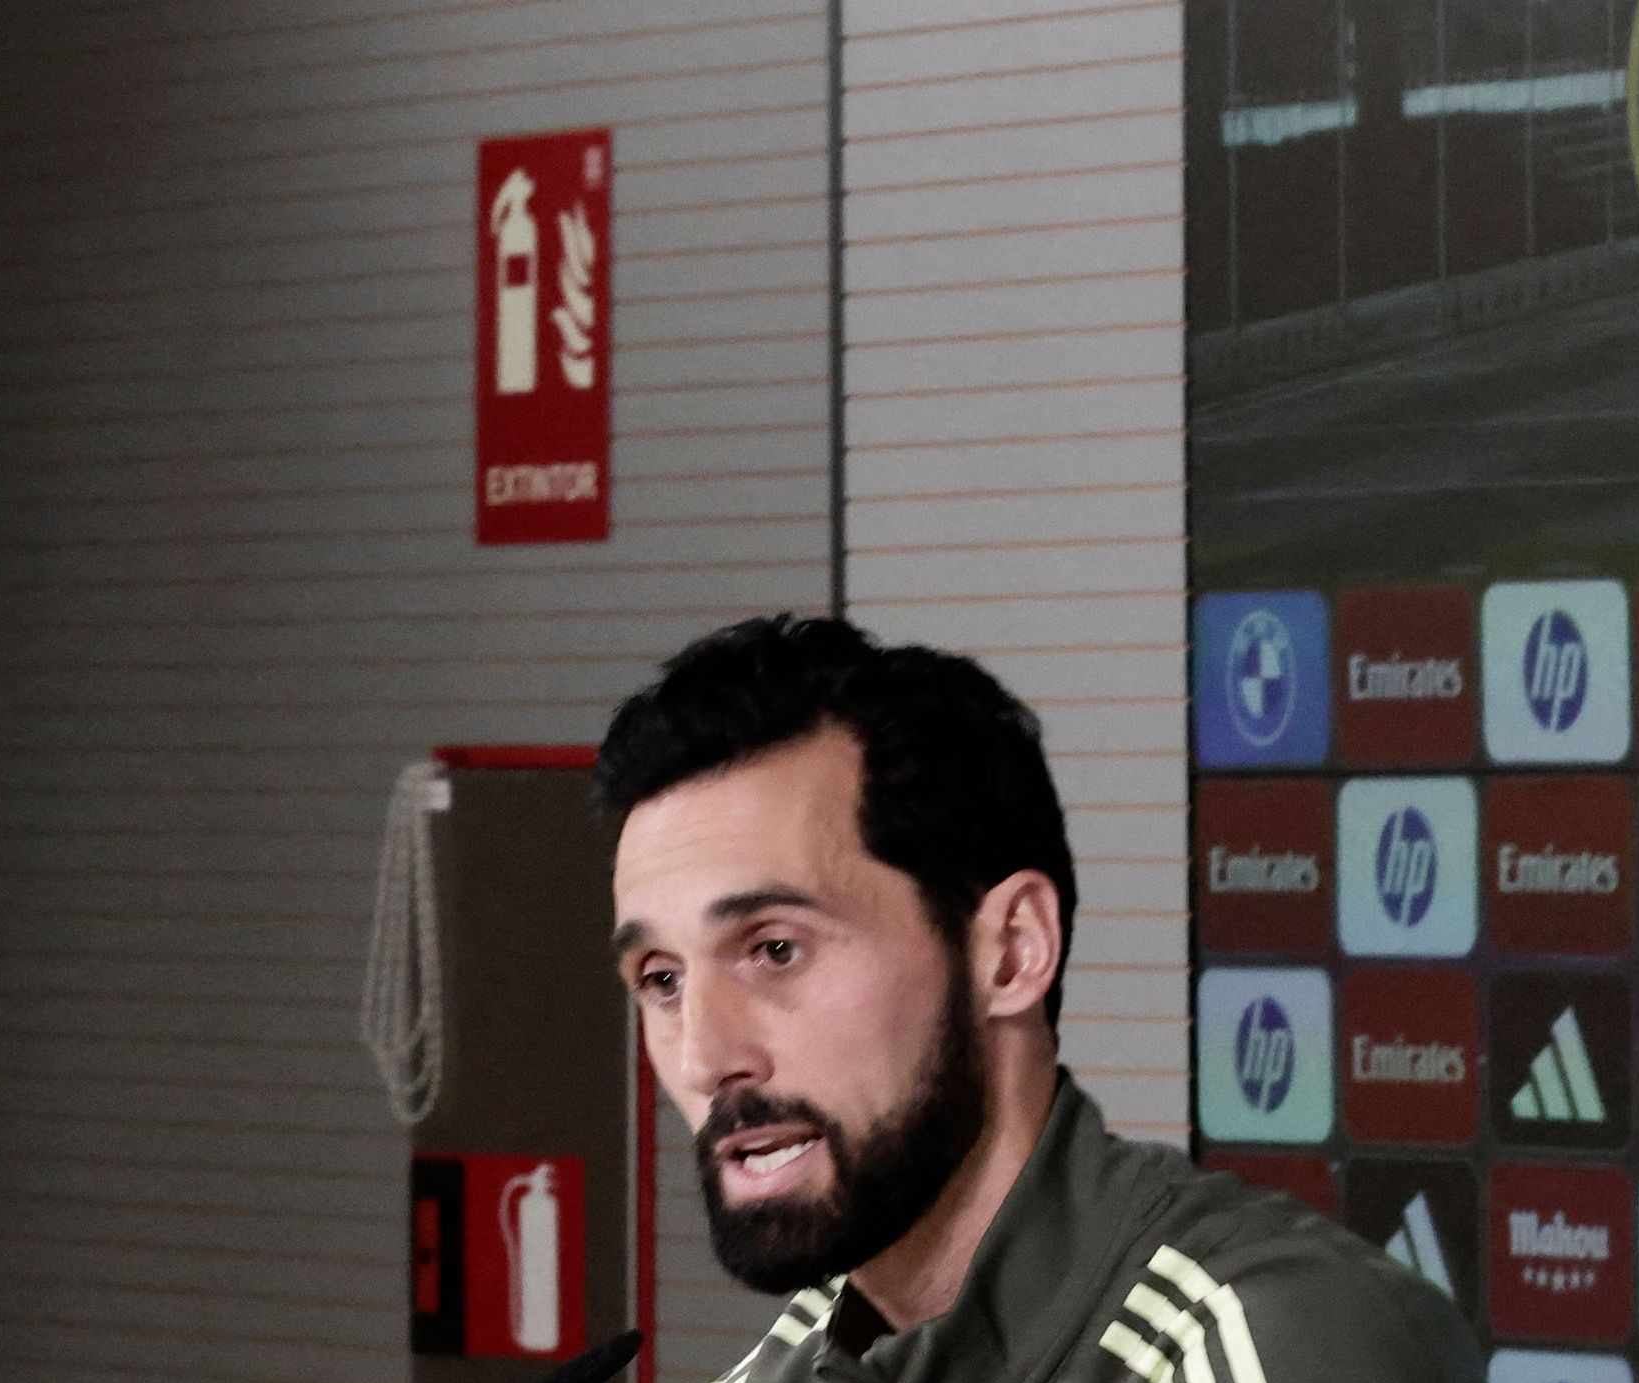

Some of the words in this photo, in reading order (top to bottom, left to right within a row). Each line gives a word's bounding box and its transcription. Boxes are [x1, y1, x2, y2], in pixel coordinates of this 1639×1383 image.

[1346, 652, 1465, 702] Emirates
[1528, 610, 1584, 731] hp
[1206, 845, 1321, 894] Emirates
[1381, 808, 1433, 927] hp
[1496, 842, 1620, 894] Emirates
[1240, 998, 1290, 1113] hp
[1350, 1033, 1468, 1085] Emirates
